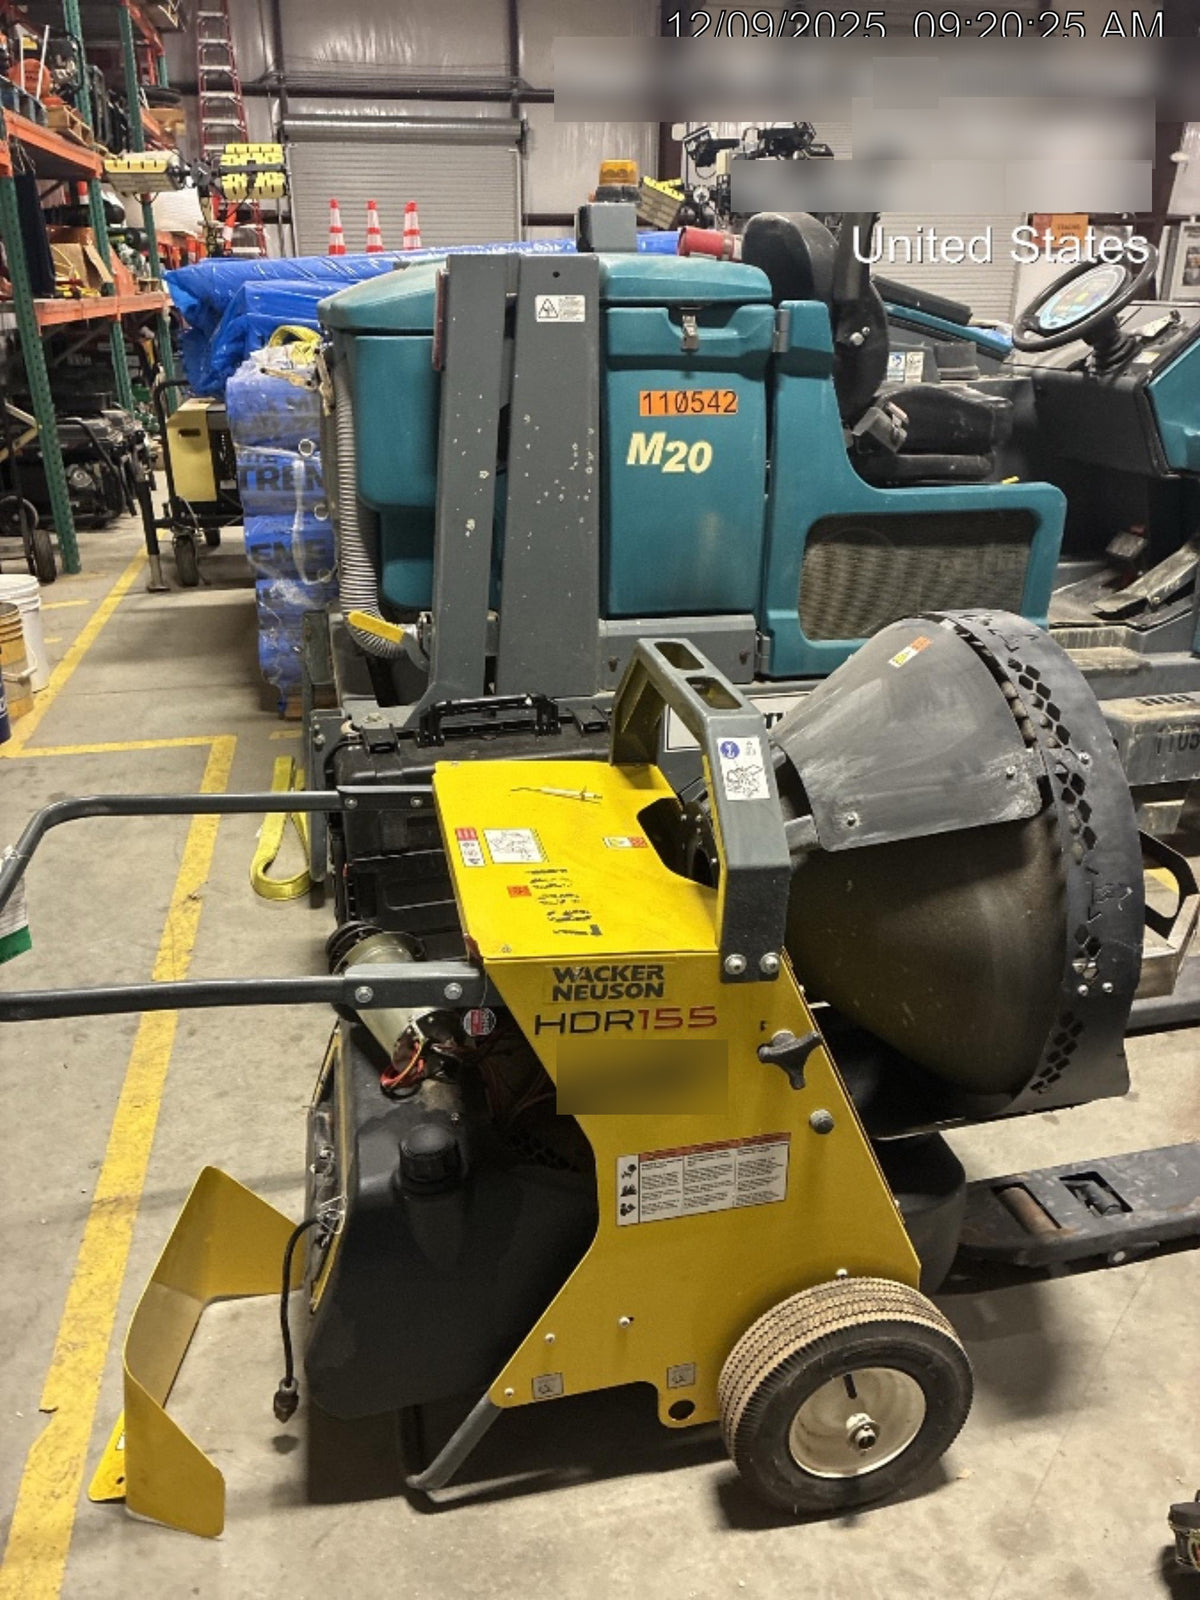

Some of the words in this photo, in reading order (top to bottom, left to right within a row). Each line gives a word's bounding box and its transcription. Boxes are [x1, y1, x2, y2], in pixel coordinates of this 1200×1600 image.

[643, 390, 738, 415] 110542
[627, 431, 713, 474] M20
[553, 965, 664, 983] WACKER
[553, 983, 664, 1001] NEUSON
[534, 1006, 717, 1035] HDR155
